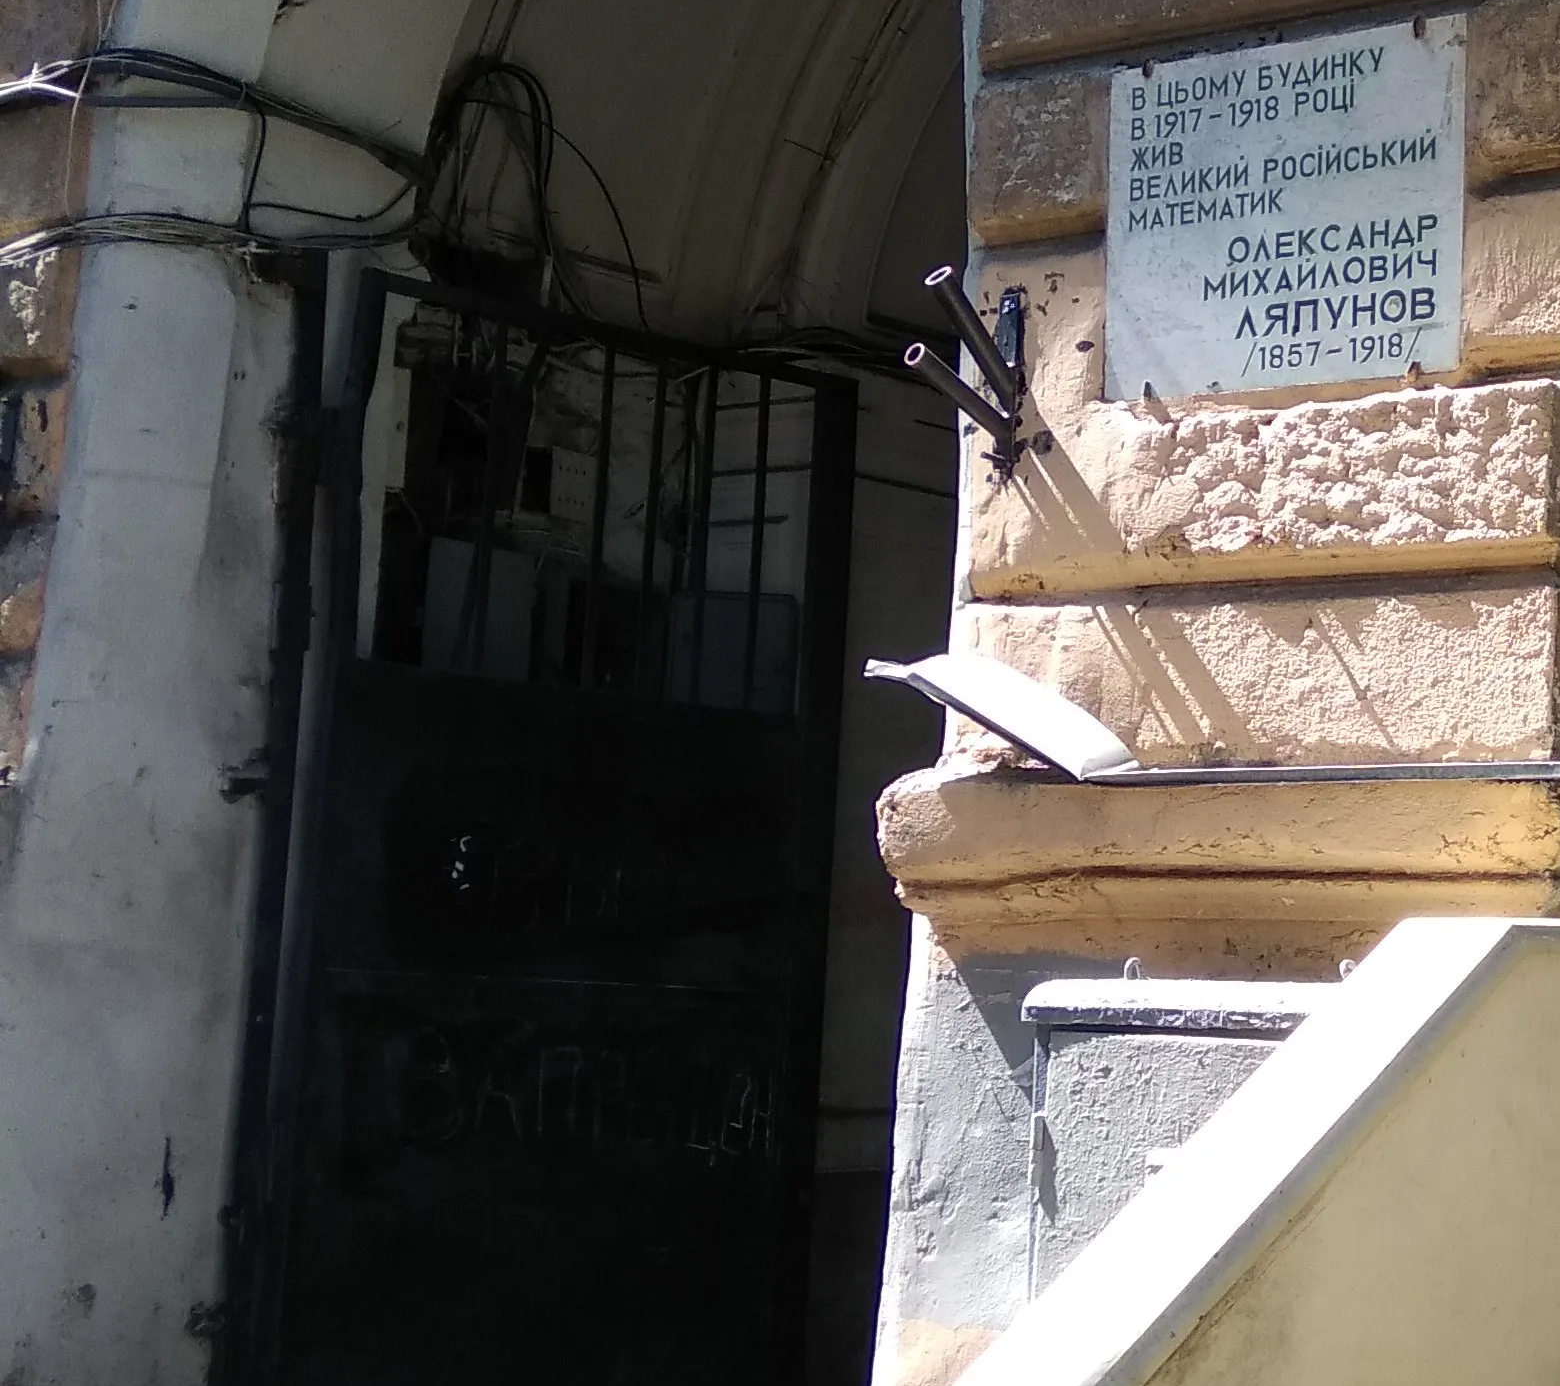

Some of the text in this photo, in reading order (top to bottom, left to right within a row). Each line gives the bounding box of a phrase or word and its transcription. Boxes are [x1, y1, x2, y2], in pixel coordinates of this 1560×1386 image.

[1131, 46, 1384, 112] В ЦЬОМУ БУДИНКУ
[1131, 117, 1146, 141] В
[1294, 79, 1355, 117] РОЦІ
[1129, 128, 1437, 202] ВЕЛИКИЙ РОСІЙСЬКИЙ
[1130, 141, 1184, 172] ЖИВ
[1129, 188, 1284, 232] МАТЕМАТИК
[1228, 214, 1438, 264] ОЛЕКСАНДР
[1203, 248, 1438, 302] МИХАЙЛОВИЧ
[1234, 287, 1436, 340] ЛЯПУНОВ
